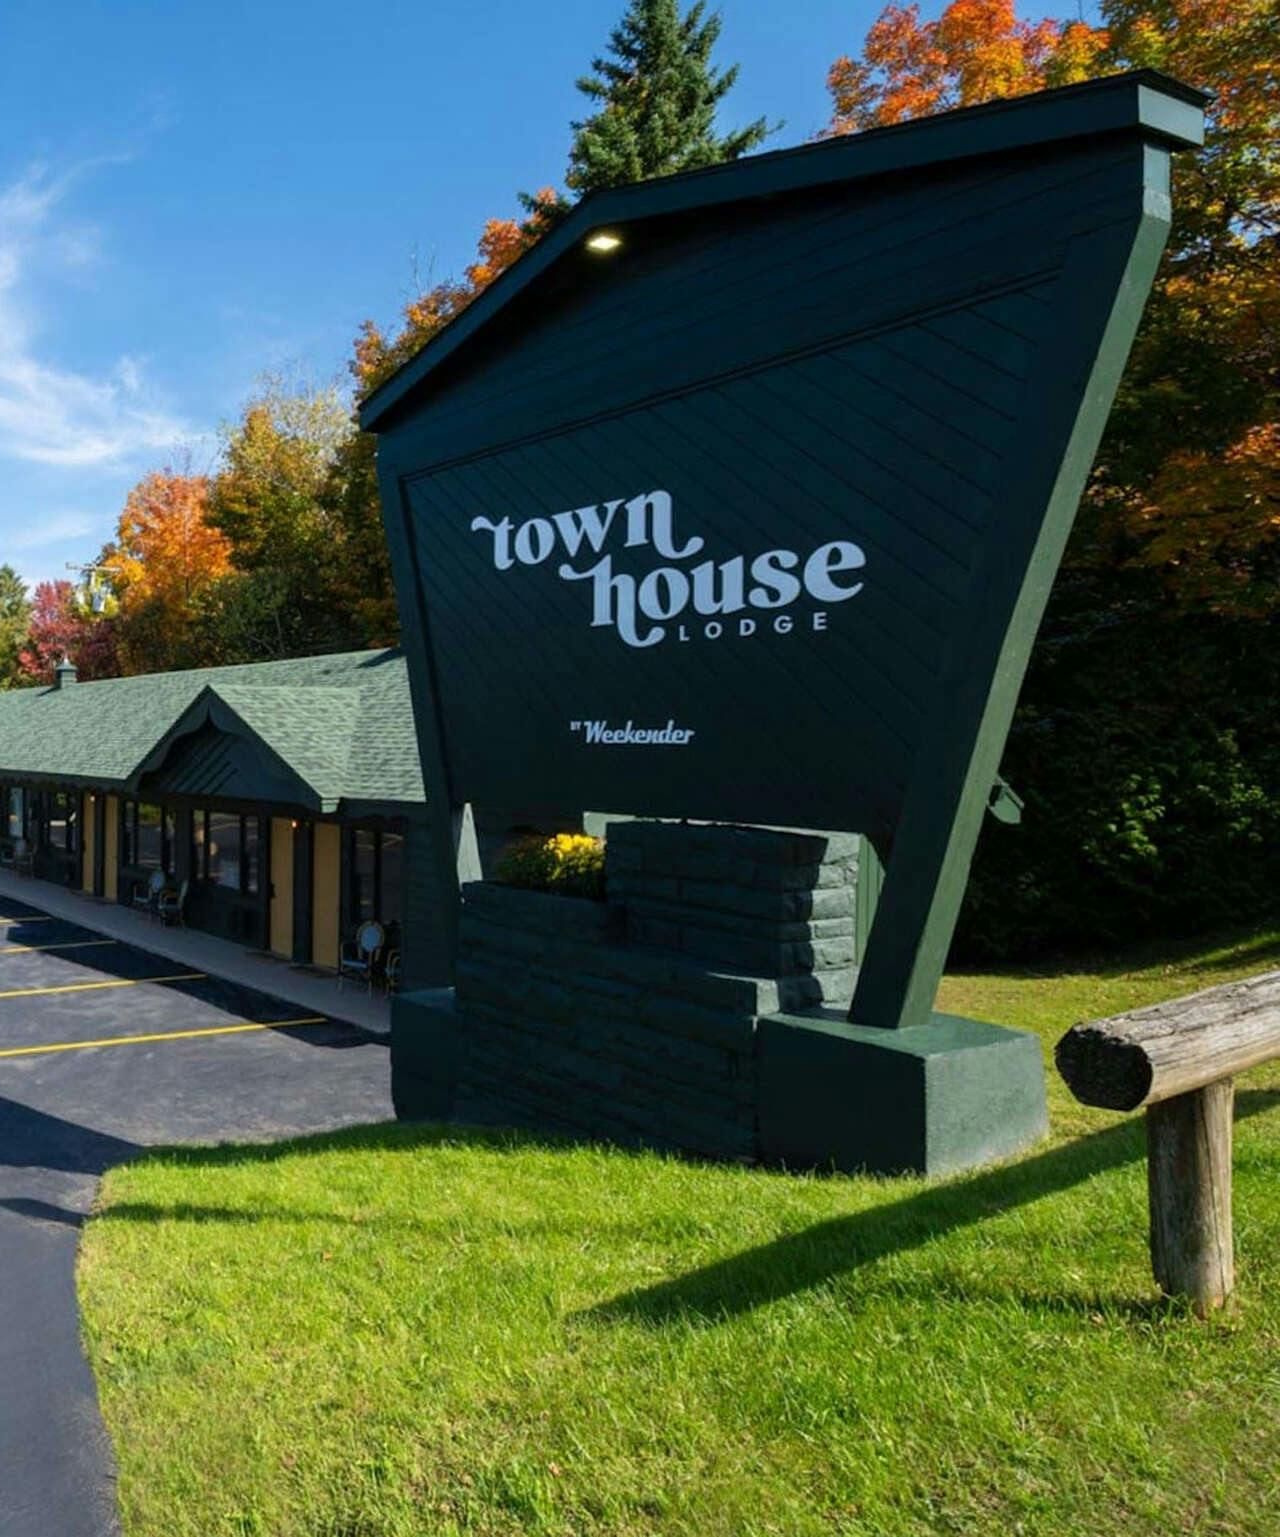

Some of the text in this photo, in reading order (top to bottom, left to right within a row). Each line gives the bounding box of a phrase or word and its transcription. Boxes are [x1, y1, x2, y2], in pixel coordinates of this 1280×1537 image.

[471, 489, 705, 571] town
[559, 540, 867, 648] house
[679, 611, 828, 642] LODGE
[583, 719, 695, 745] Weekender
